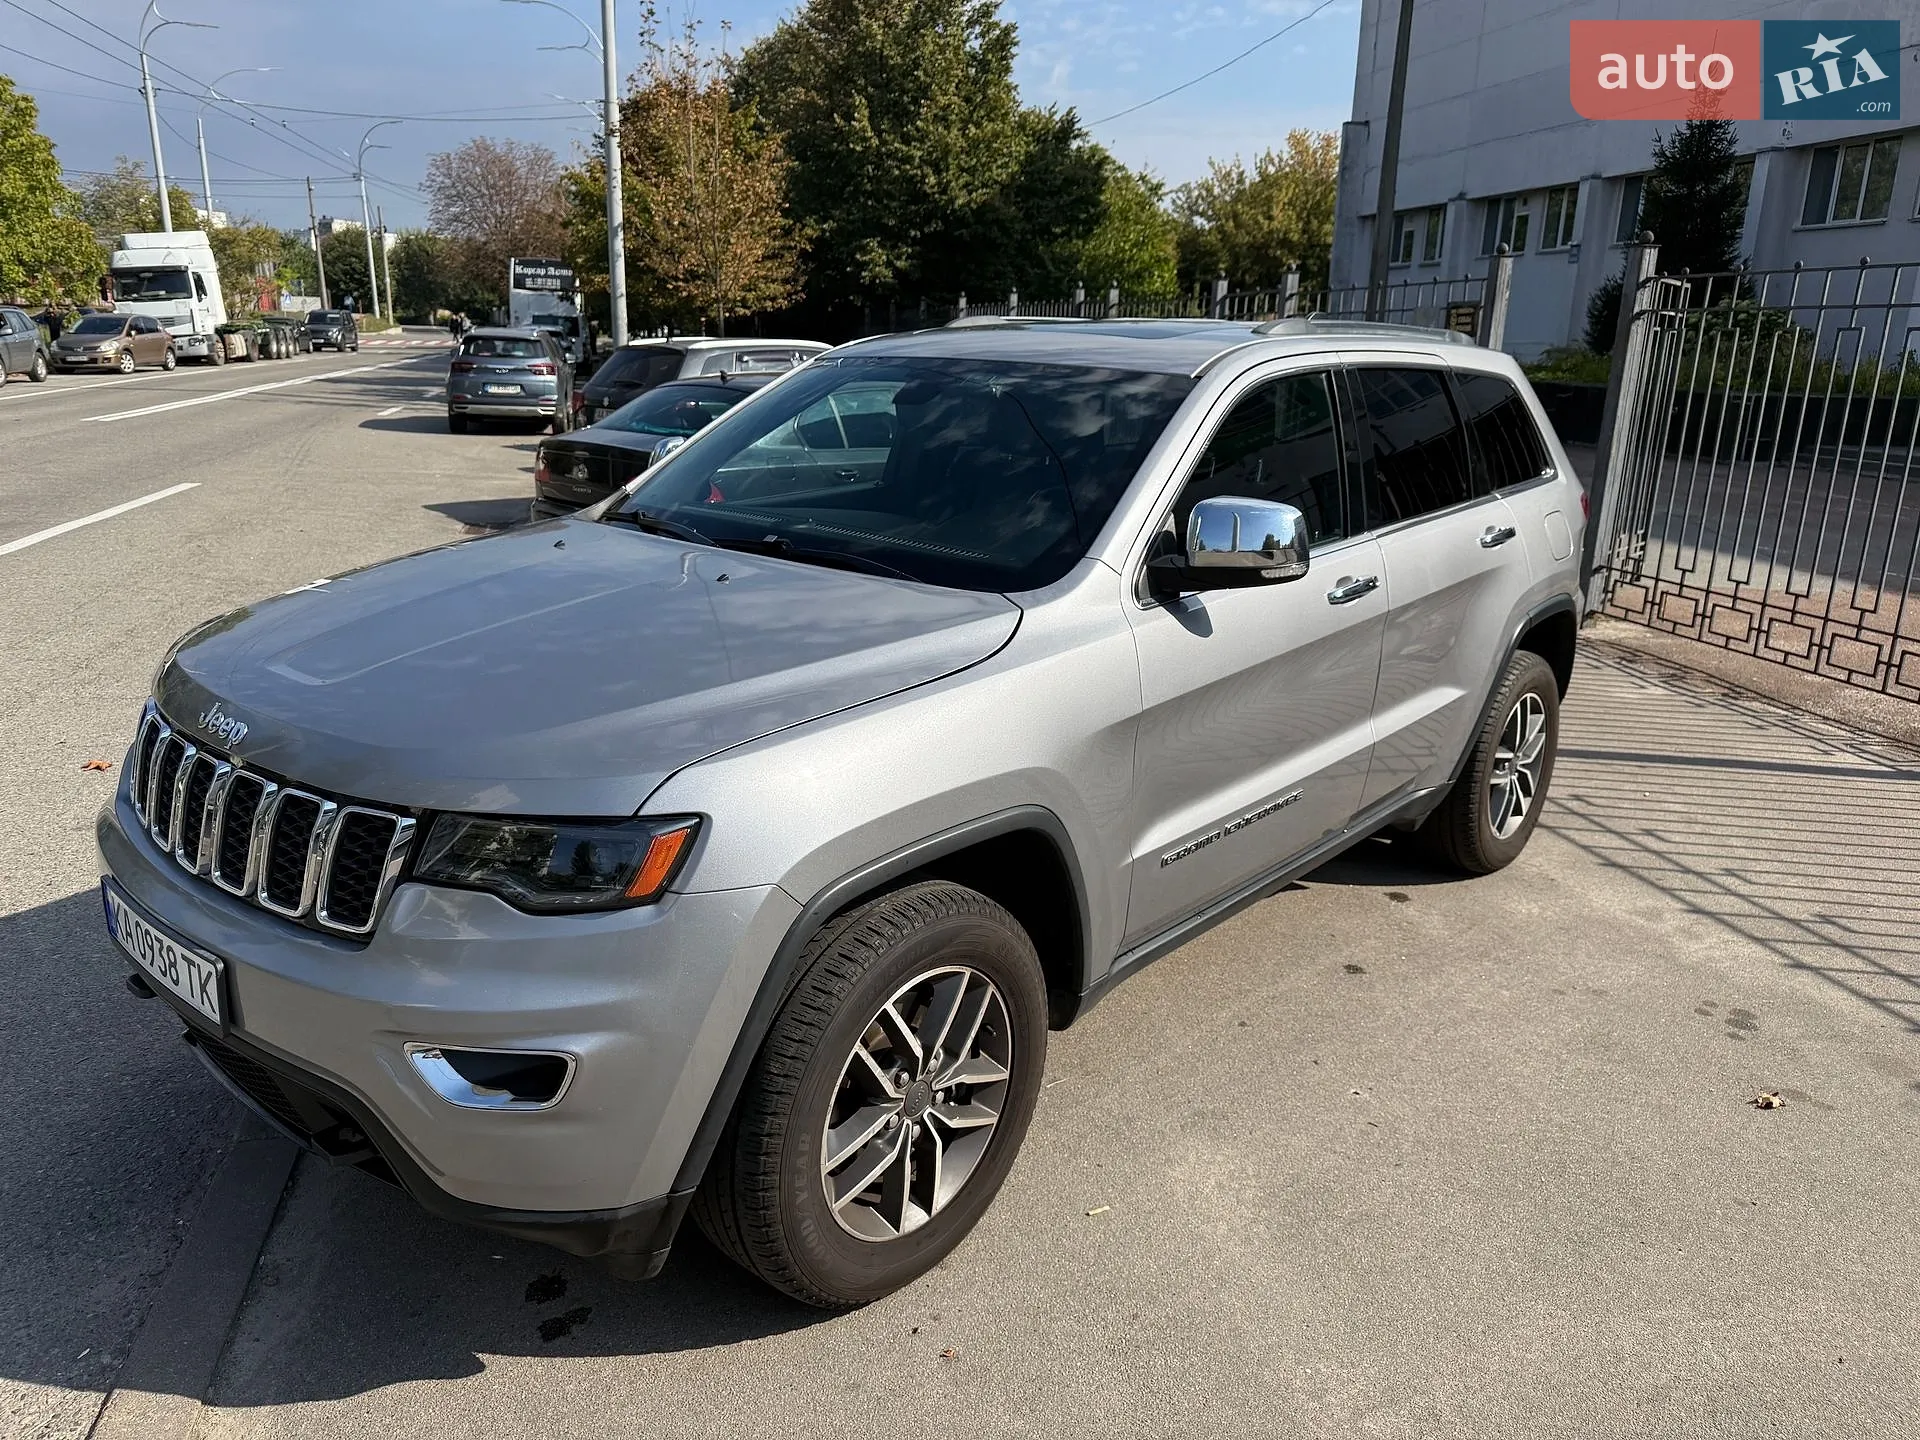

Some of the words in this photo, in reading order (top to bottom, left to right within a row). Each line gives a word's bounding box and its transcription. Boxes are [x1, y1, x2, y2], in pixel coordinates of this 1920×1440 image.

[199, 702, 249, 750] Jeep
[1160, 829, 1221, 869] GRAND
[1224, 788, 1304, 837] CHEROKEE
